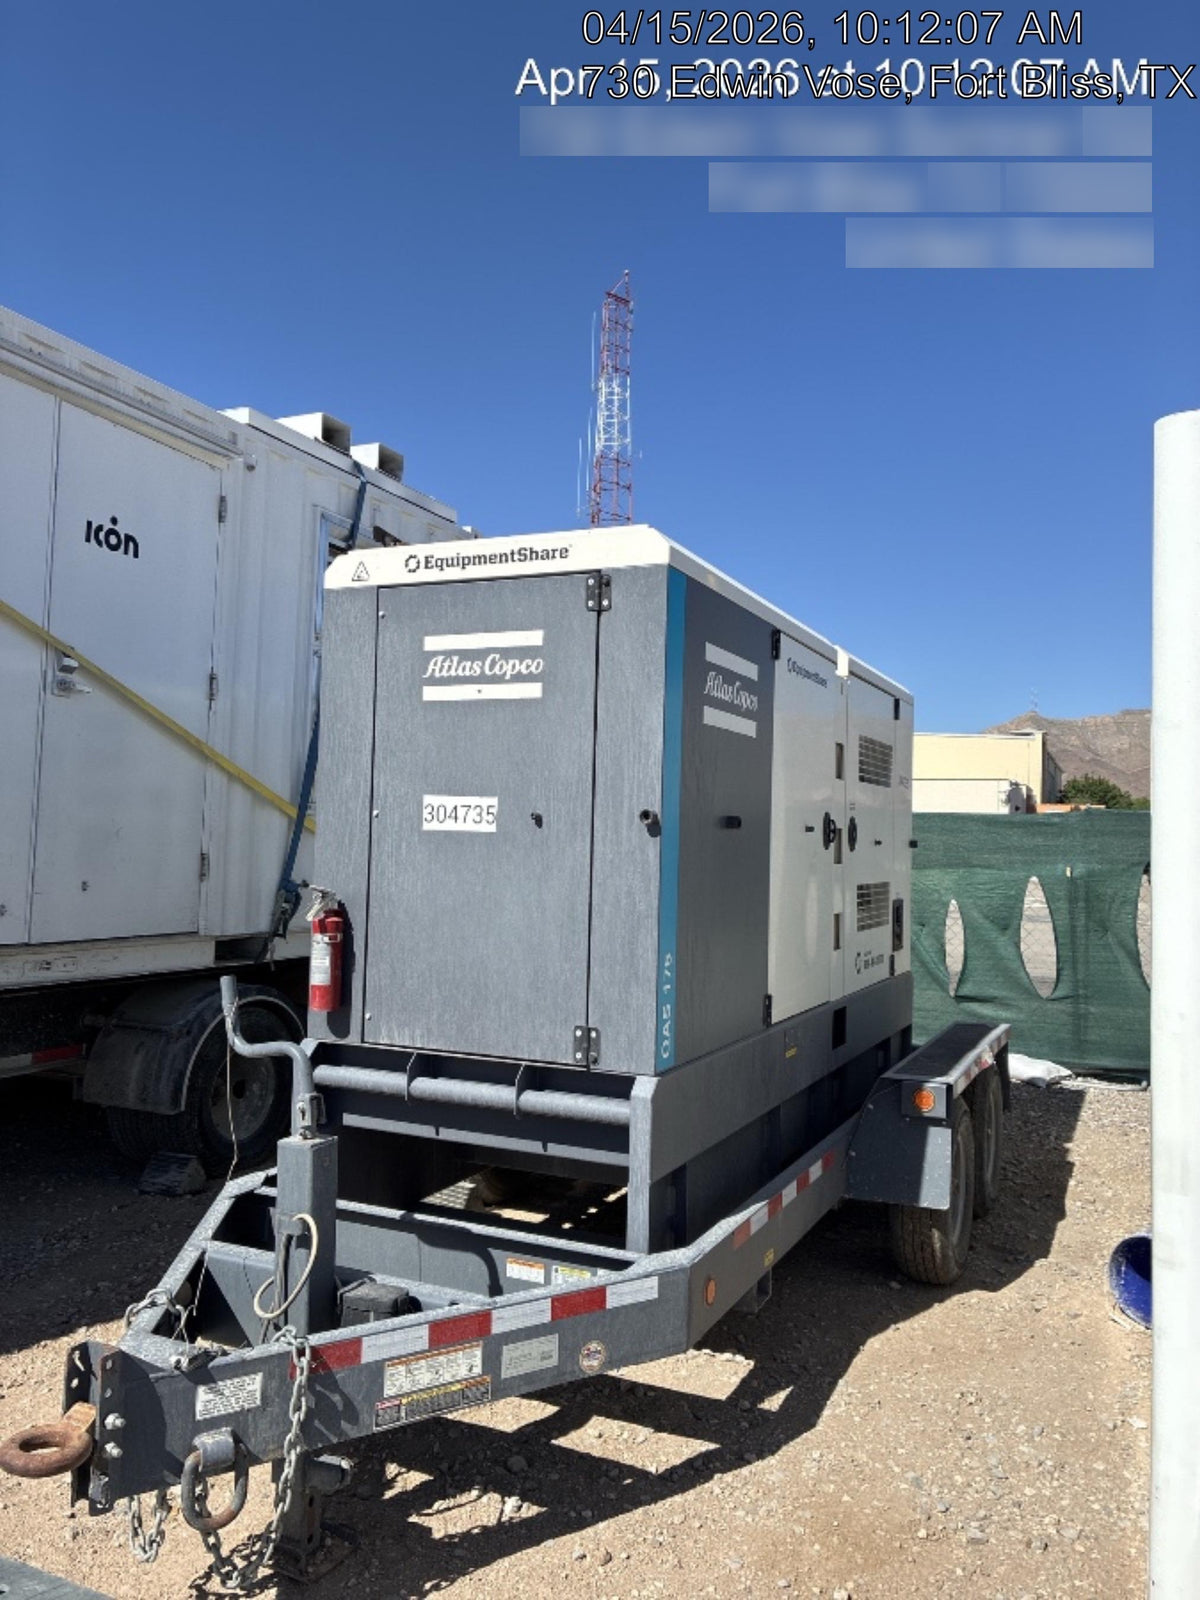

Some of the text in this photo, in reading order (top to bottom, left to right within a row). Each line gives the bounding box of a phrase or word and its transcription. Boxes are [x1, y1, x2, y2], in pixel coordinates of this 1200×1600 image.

[424, 546, 570, 571] EquipmentShare
[422, 653, 544, 679] Atlas Copco
[424, 803, 496, 825] 304735
